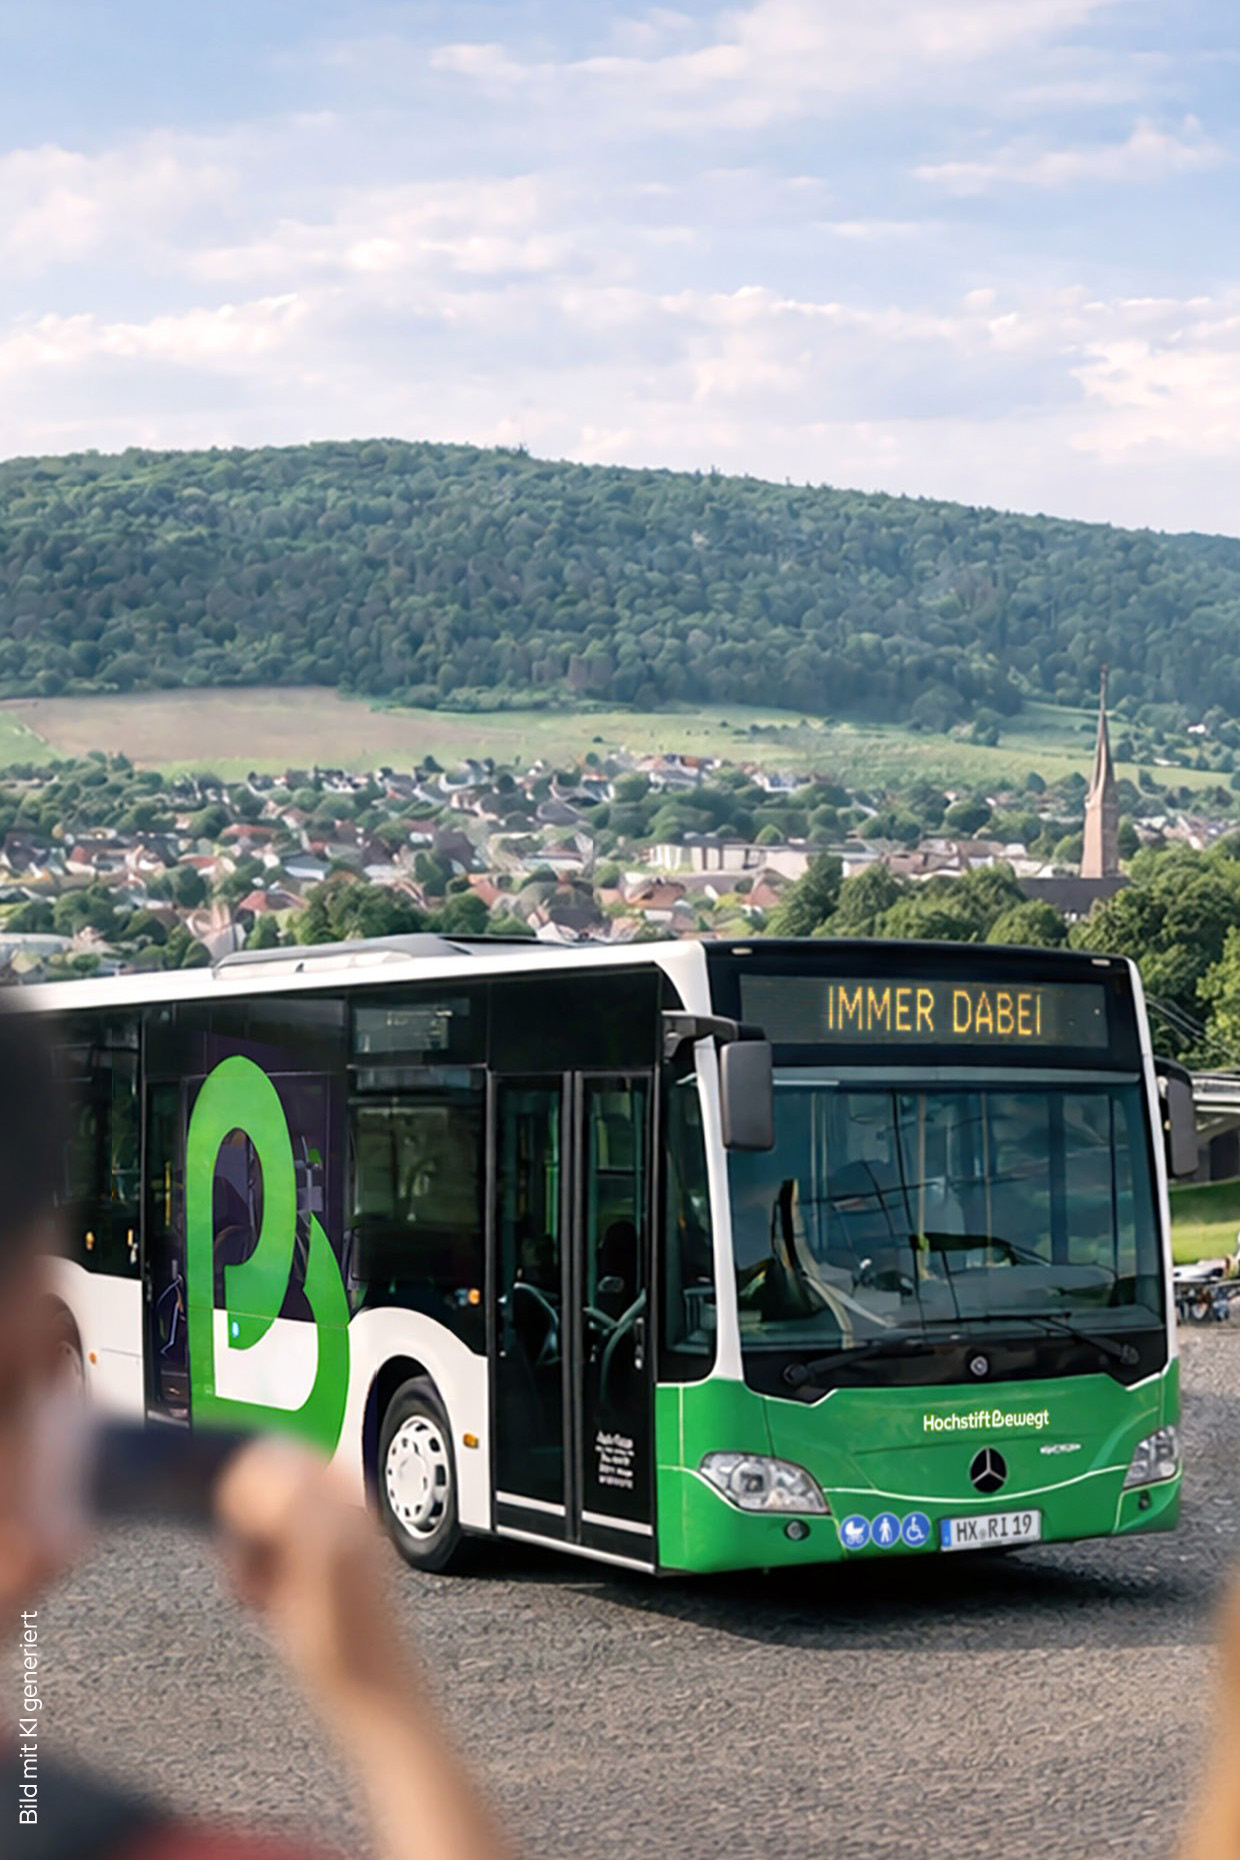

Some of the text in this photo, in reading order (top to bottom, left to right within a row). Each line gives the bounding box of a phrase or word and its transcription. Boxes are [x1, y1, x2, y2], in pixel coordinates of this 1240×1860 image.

[828, 985, 1041, 1036] IMMER DABEI
[956, 1513, 1032, 1542] HX RI 19
